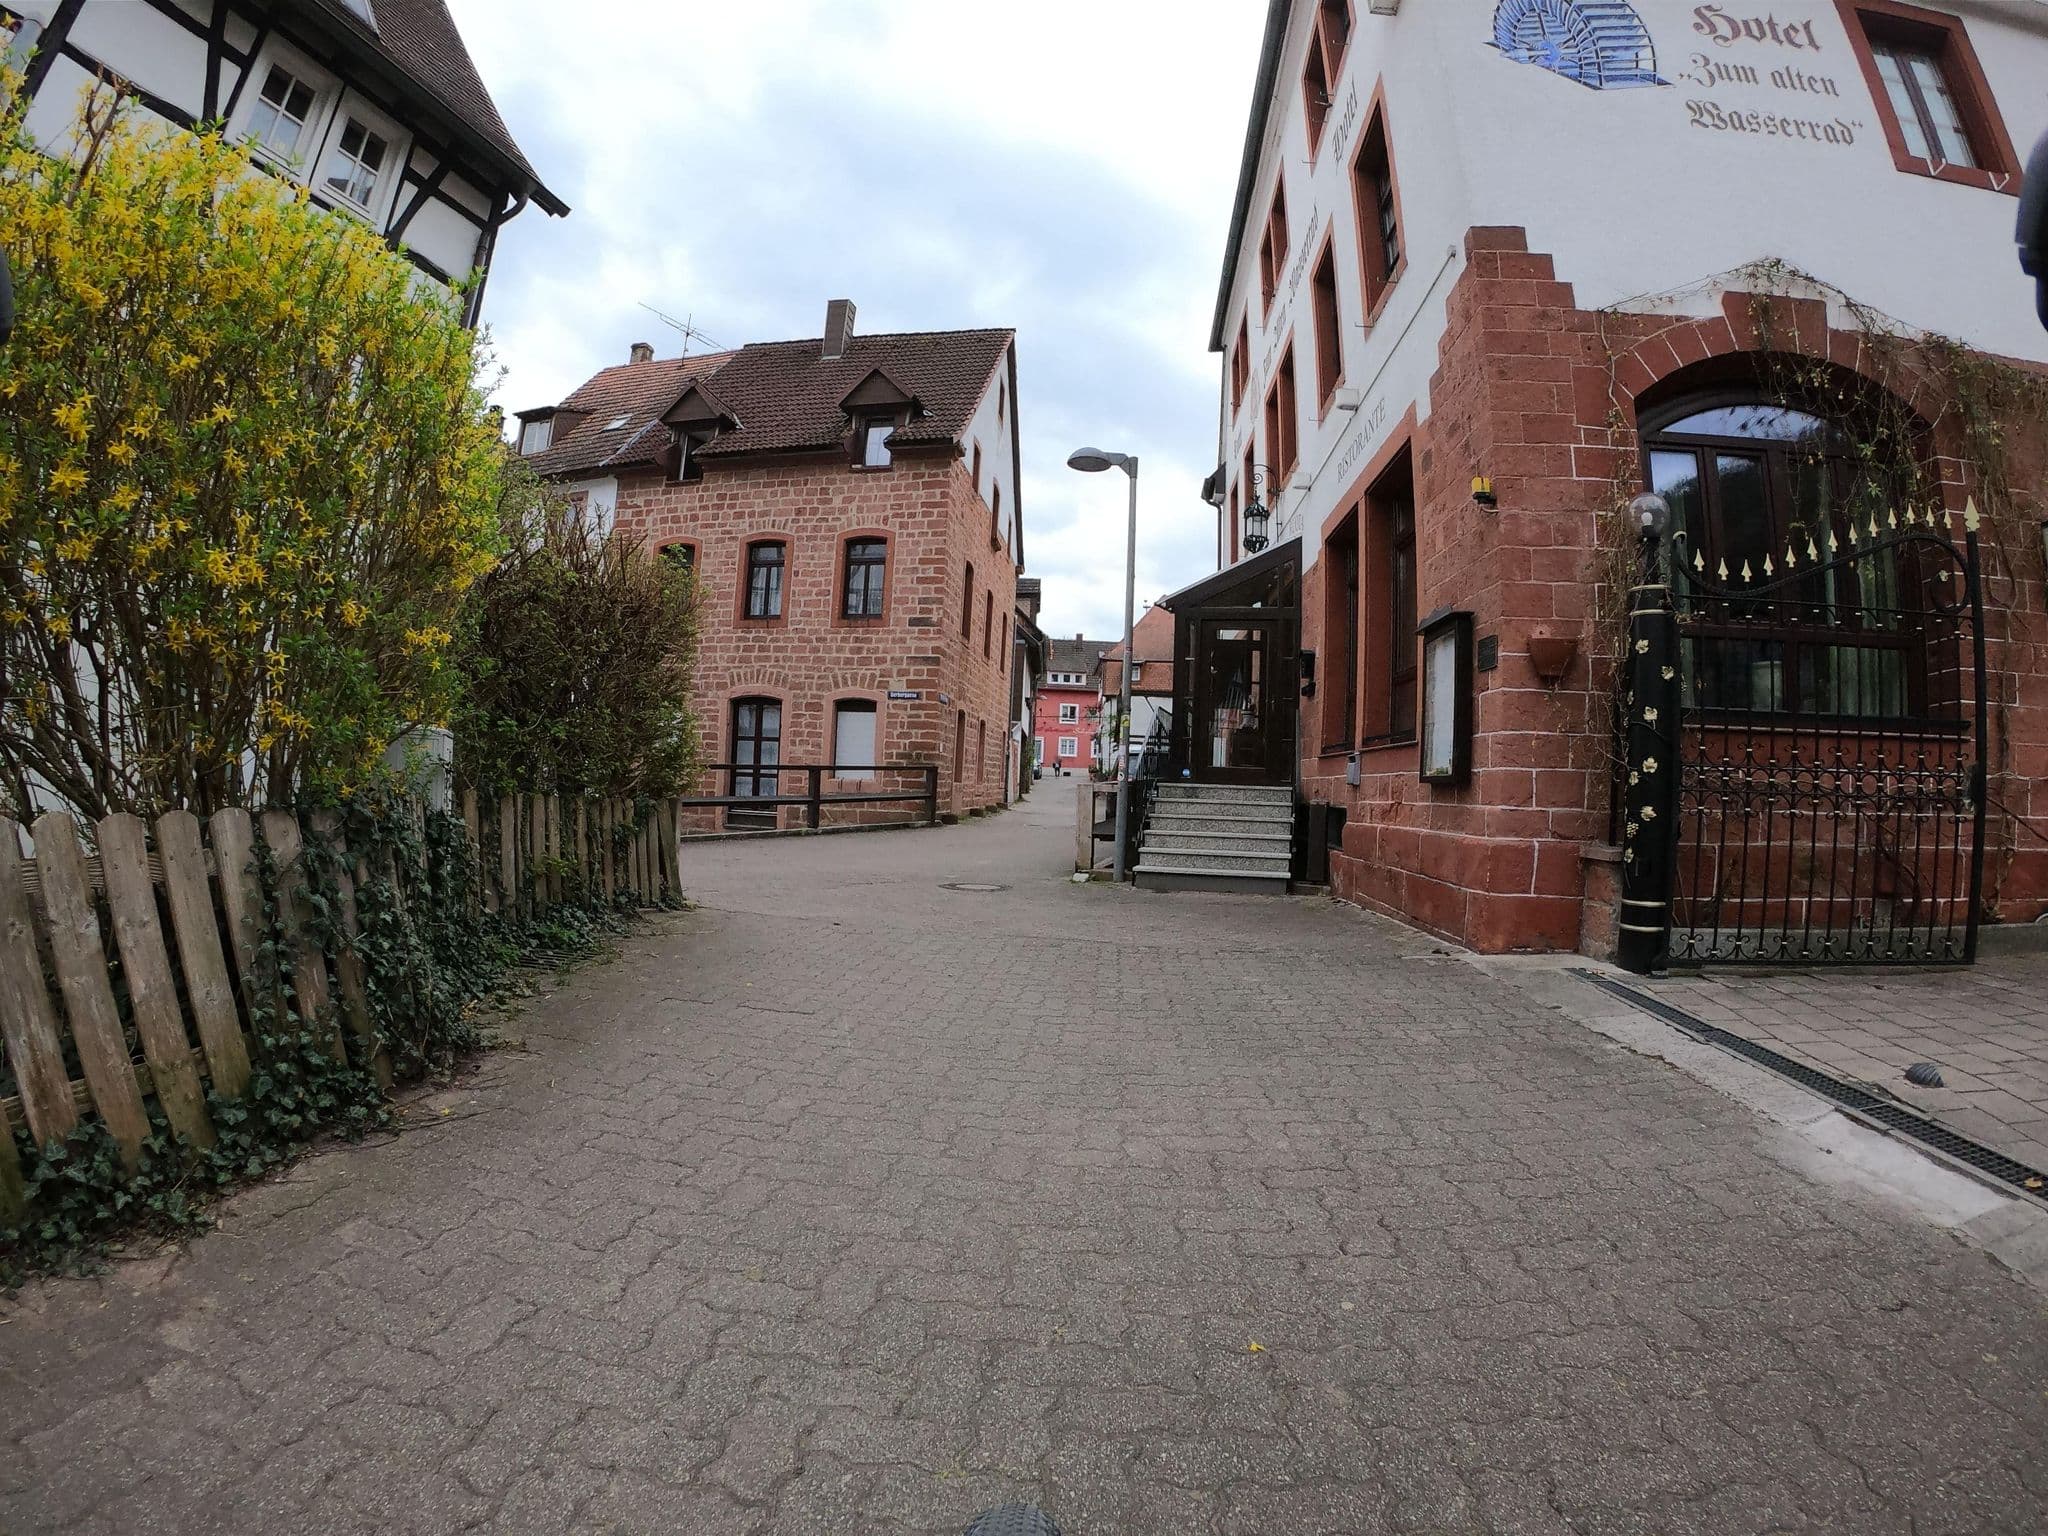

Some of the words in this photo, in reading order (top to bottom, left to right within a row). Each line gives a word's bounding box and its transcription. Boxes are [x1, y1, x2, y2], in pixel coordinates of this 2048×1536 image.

[1693, 4, 1820, 50] Hotel
[1770, 65, 1840, 97] alten
[1336, 398, 1387, 484] RISTORANTE
